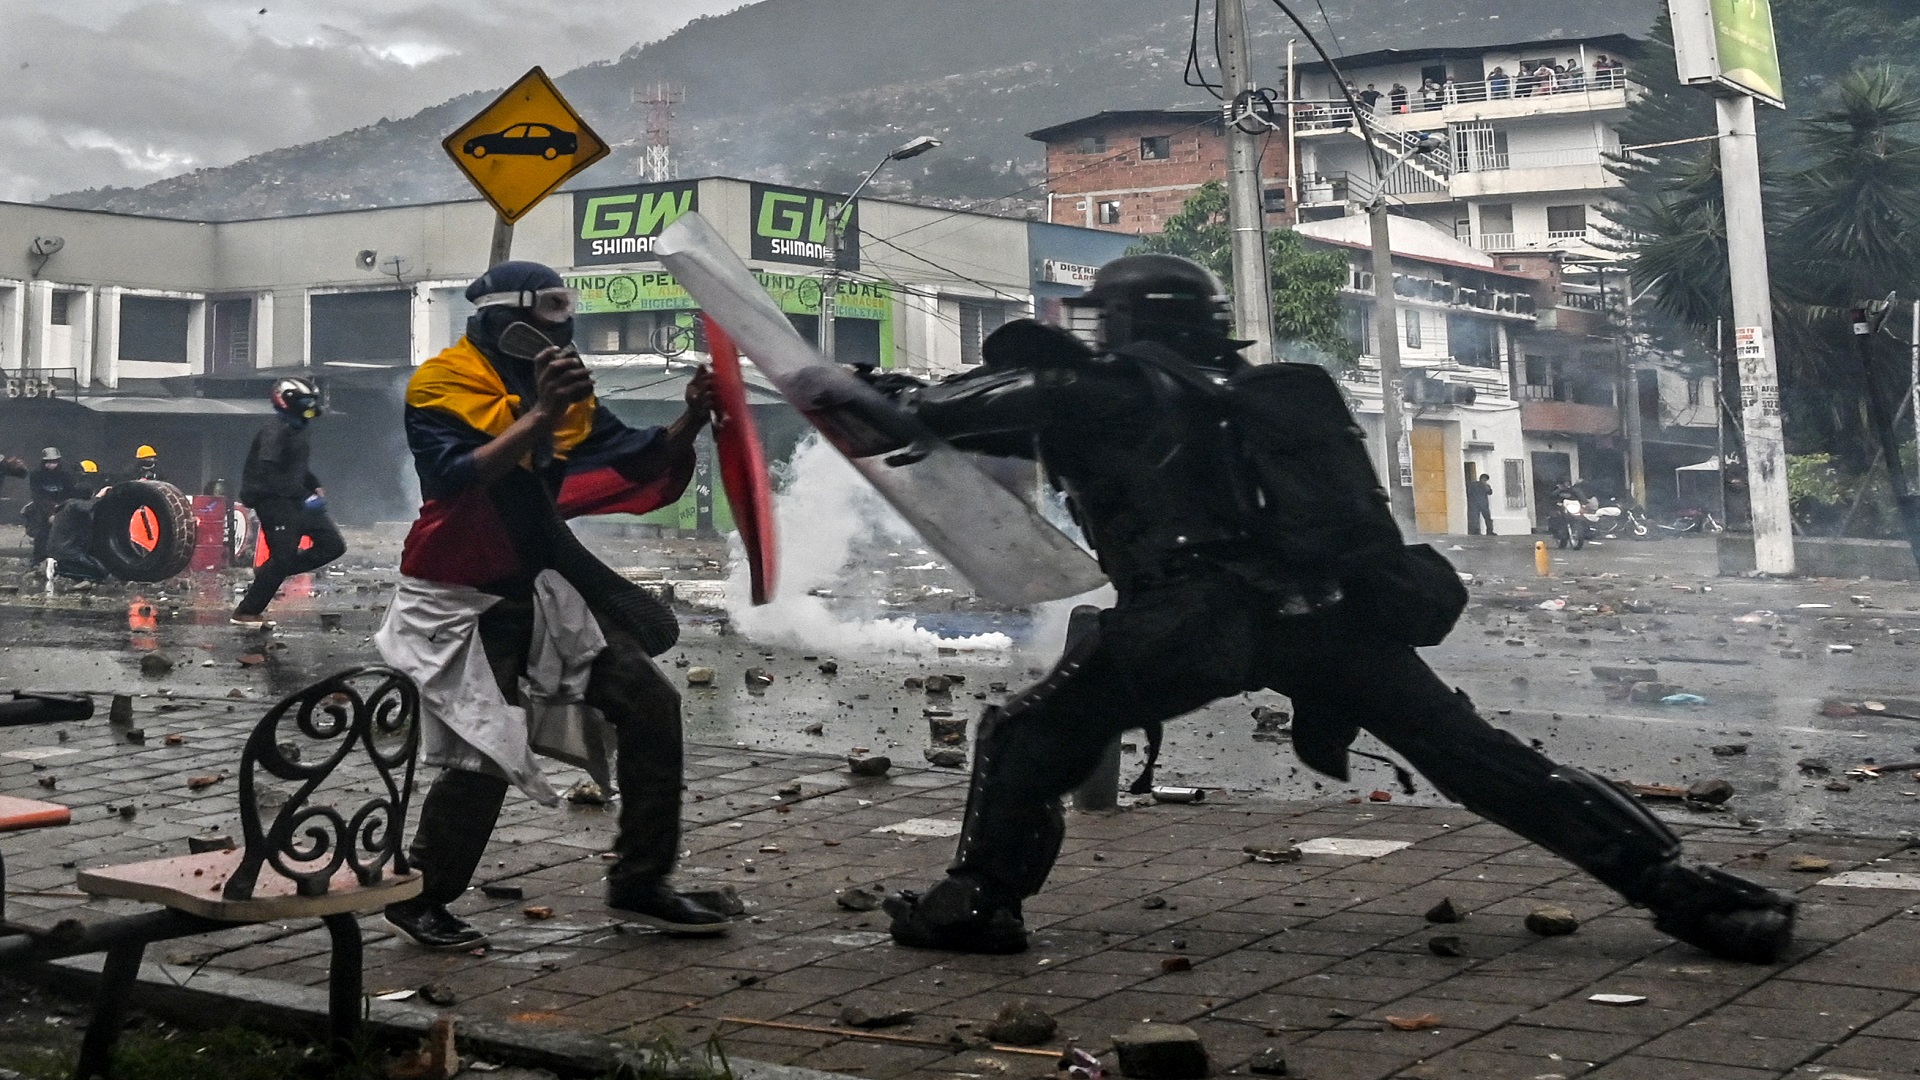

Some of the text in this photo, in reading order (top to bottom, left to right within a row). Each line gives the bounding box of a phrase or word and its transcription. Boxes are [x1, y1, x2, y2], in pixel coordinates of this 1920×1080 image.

[580, 190, 693, 240] GW
[756, 190, 853, 244] GW
[836, 280, 882, 299] EDAL
